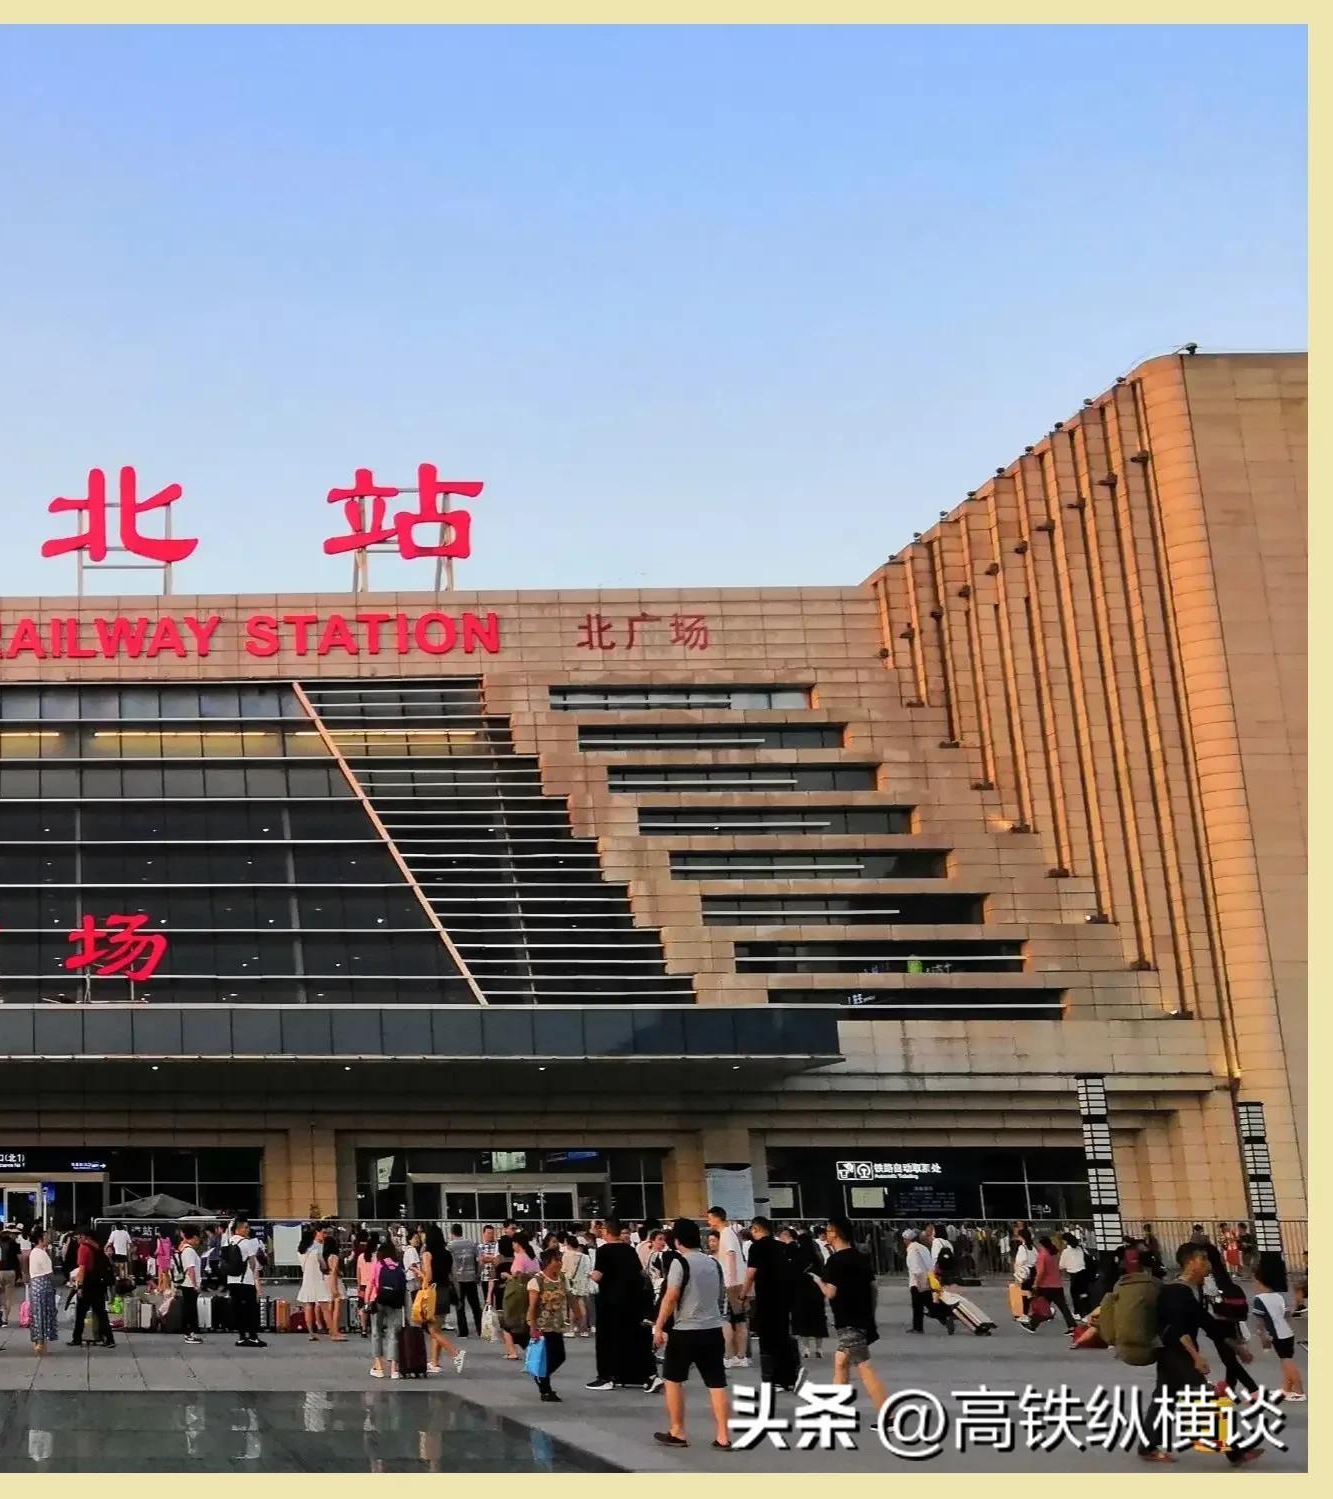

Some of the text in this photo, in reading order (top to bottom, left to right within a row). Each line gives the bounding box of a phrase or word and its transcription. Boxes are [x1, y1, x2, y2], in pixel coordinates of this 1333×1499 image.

[244, 610, 501, 658] STATION
[577, 612, 709, 650] 北广场
